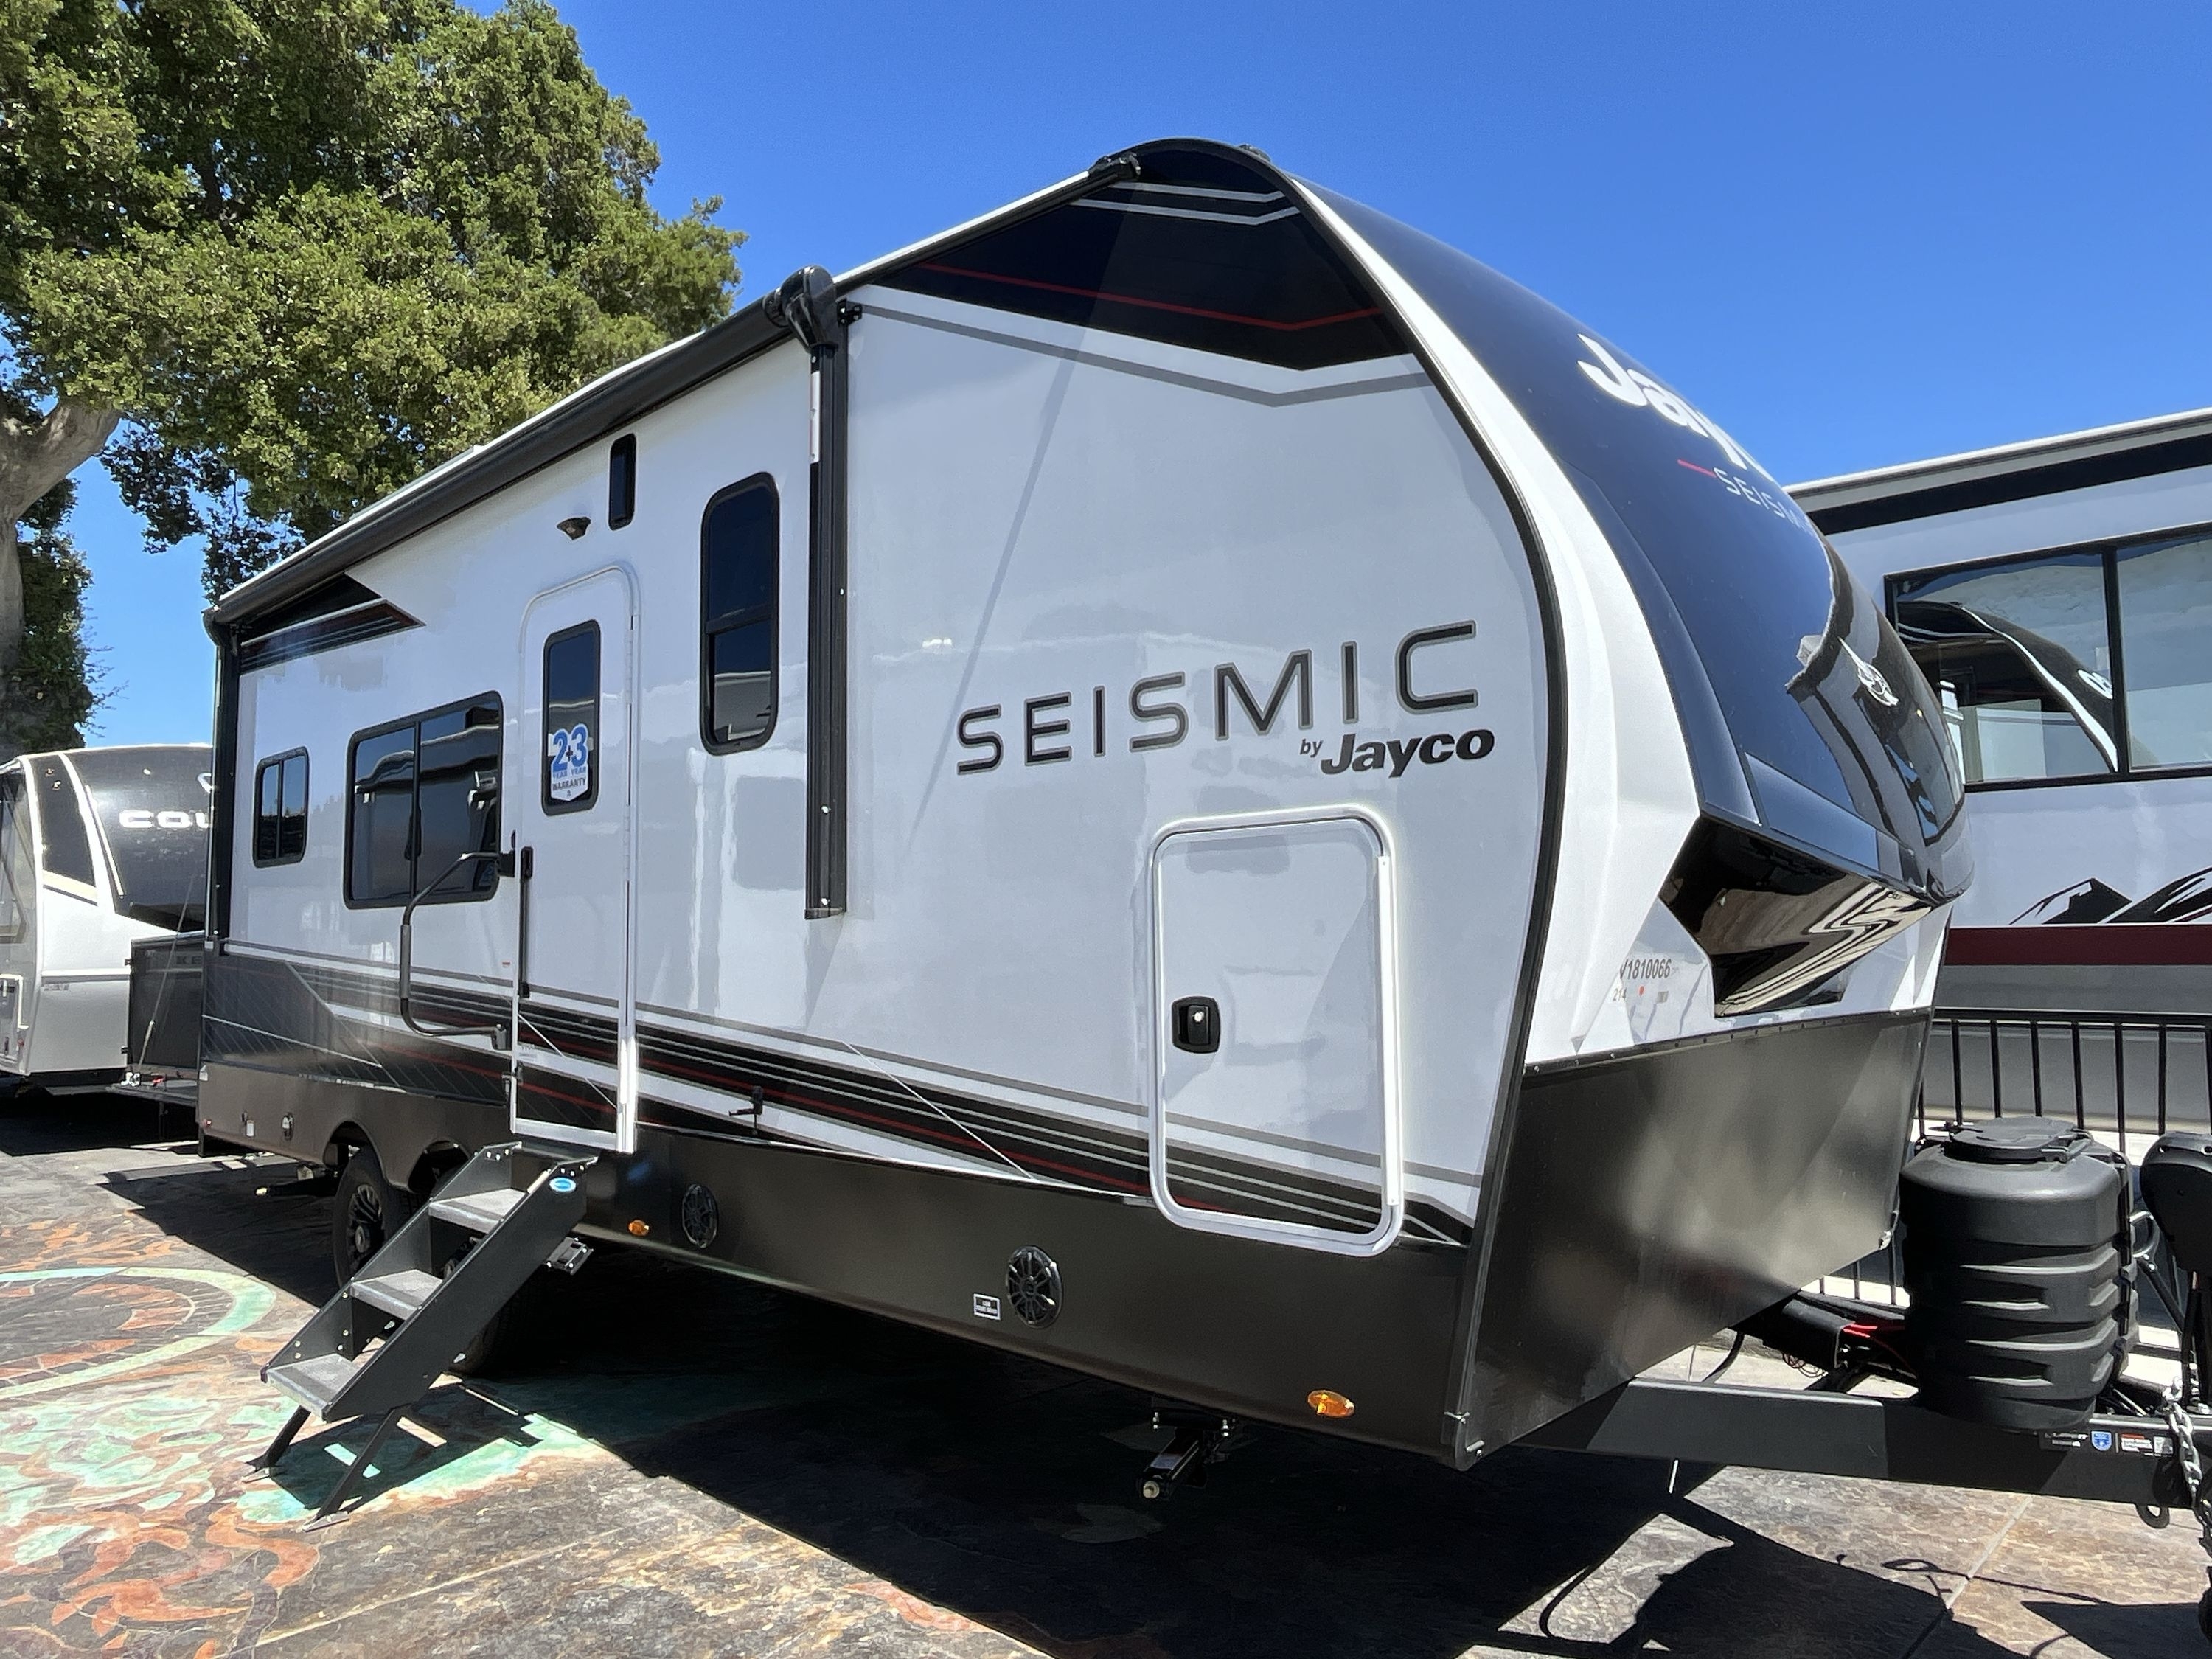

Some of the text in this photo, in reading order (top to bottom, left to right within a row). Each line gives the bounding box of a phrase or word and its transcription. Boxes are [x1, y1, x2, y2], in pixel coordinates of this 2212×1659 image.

[956, 619, 1479, 776] SEISMIC
[1299, 729, 1496, 779] by Jayco
[552, 778, 586, 790] WARRANTY
